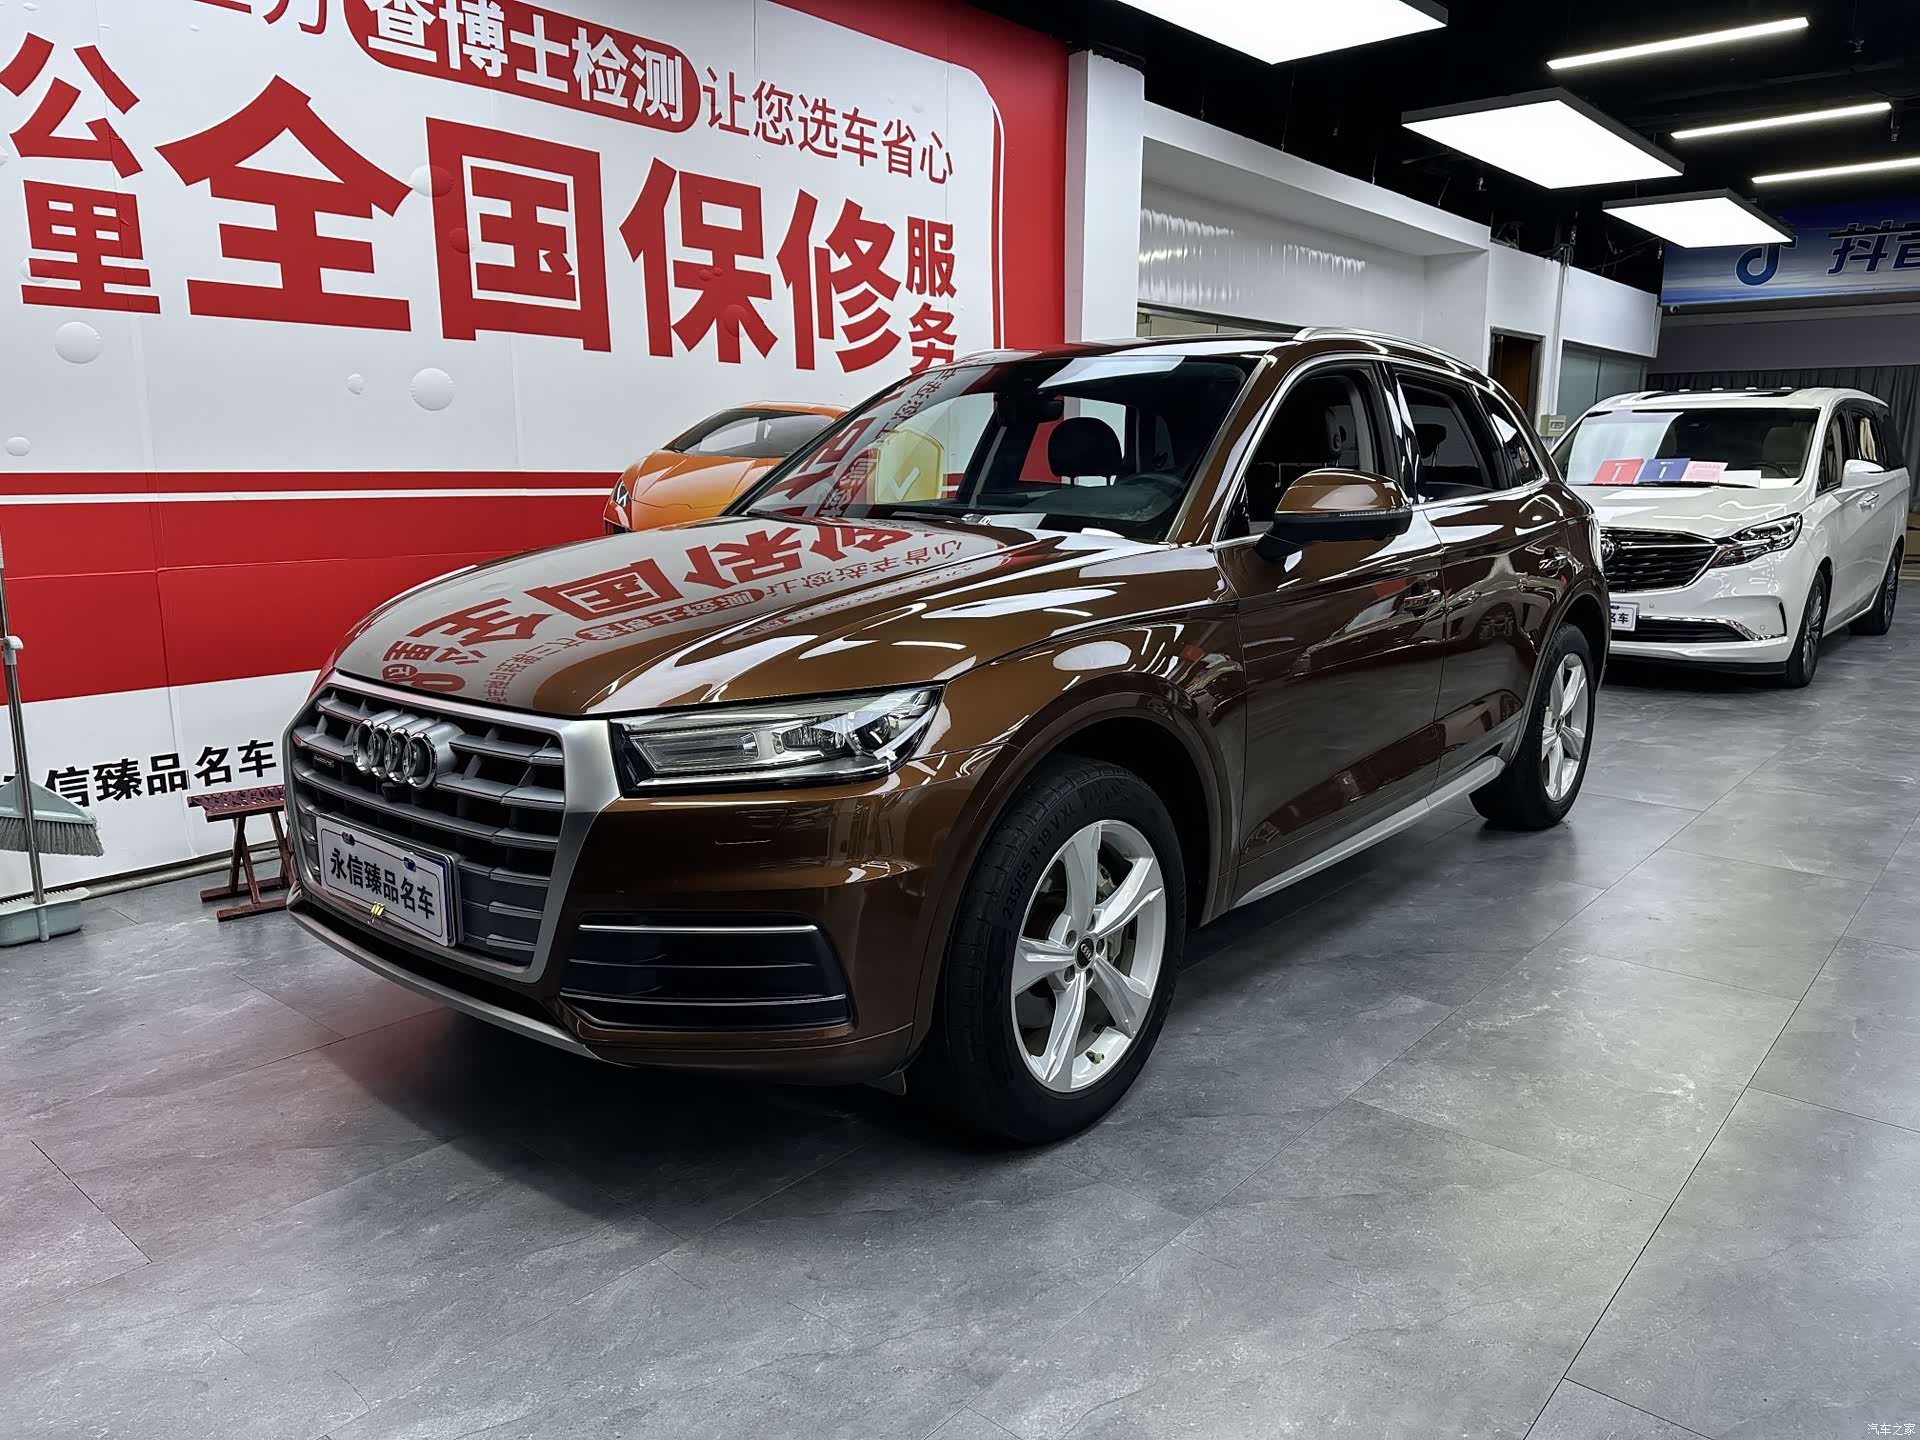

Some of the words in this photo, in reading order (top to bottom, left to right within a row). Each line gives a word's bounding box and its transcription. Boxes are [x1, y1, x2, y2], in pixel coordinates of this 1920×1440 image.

[363, 0, 683, 124] 查博士检测
[703, 66, 954, 185] 让您选车省心
[155, 75, 902, 374] 全国保修
[905, 216, 958, 373] 服务
[0, 739, 277, 808] 信臻品名车
[330, 847, 435, 920] 永信臻品名车
